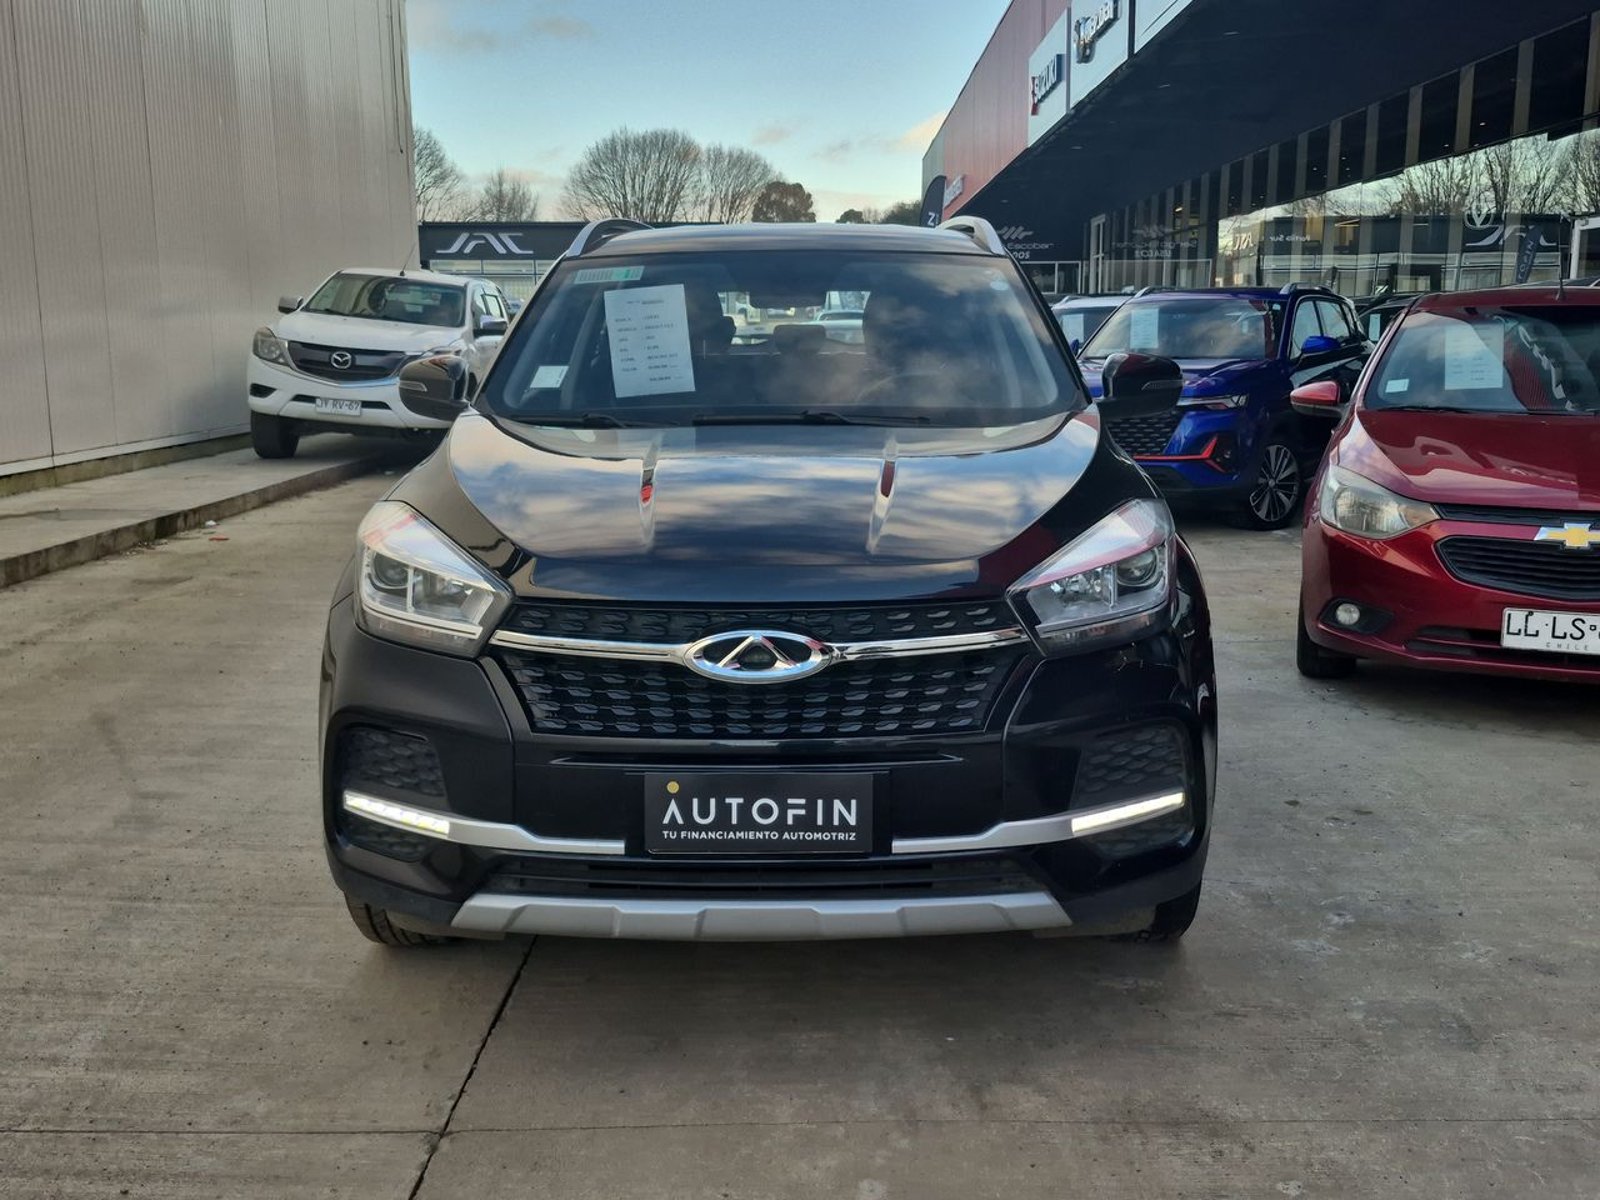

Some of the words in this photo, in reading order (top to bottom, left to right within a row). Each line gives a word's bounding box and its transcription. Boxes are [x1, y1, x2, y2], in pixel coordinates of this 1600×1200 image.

[436, 232, 534, 254] JAC
[1546, 642, 1588, 651] CHILE
[662, 797, 857, 826] AUTOFIN
[662, 830, 677, 839] TU
[680, 831, 779, 840] FINANCIAMIENTO
[782, 831, 857, 841] AUTOMOTRIZ
